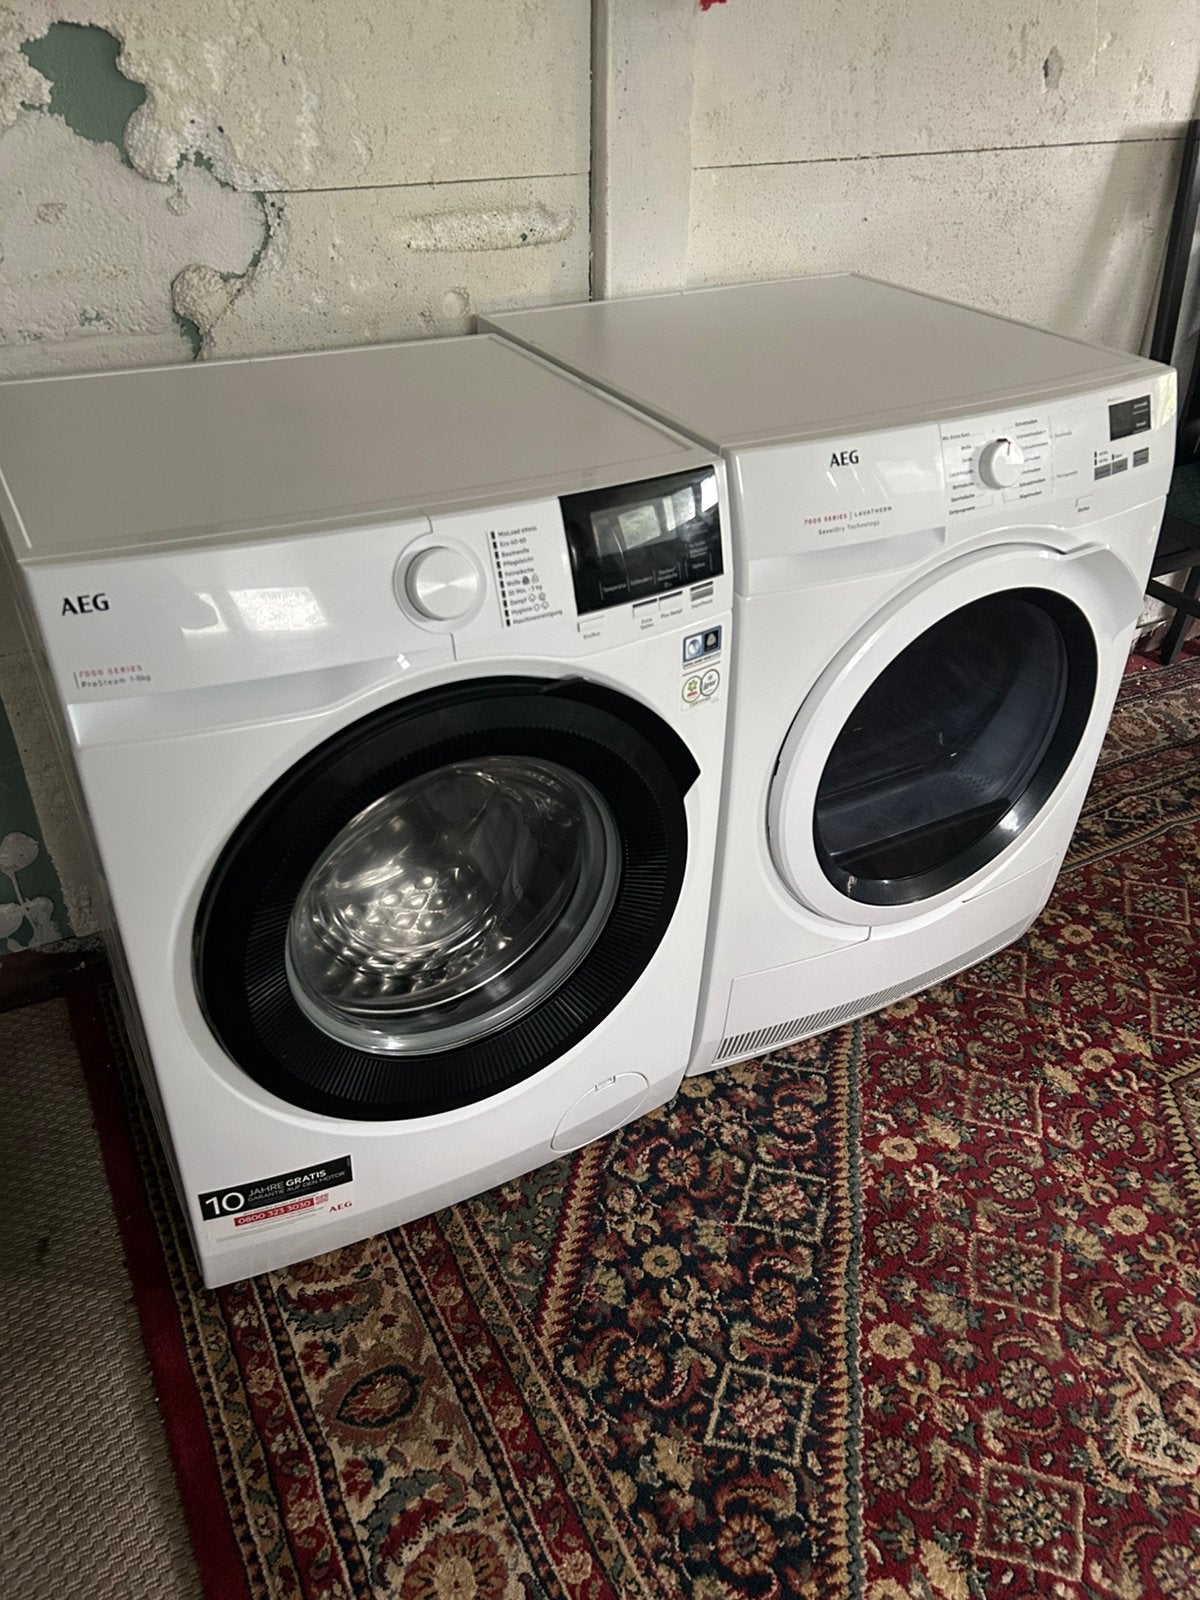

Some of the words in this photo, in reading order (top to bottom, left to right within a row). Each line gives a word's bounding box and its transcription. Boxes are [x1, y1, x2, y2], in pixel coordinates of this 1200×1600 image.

[830, 449, 859, 467] AEG
[824, 513, 847, 522] SERIES
[854, 506, 892, 517] LAVATHERM
[818, 525, 845, 535] SensiDry
[847, 520, 880, 531] Technology
[61, 593, 109, 616] AEG
[79, 669, 104, 678] 7000
[108, 664, 143, 674] SERIES
[81, 678, 126, 688] ProSteam
[205, 1192, 245, 1215] 10
[248, 1181, 284, 1197] JAHRE
[285, 1169, 327, 1187] GRATIS
[248, 1188, 285, 1202] GARANTIE
[286, 1184, 301, 1193] AUF
[302, 1180, 318, 1188] DEN
[238, 1212, 266, 1225] 0800
[268, 1208, 285, 1218] 323
[287, 1200, 311, 1212] 3030
[328, 1200, 353, 1213] AEG
